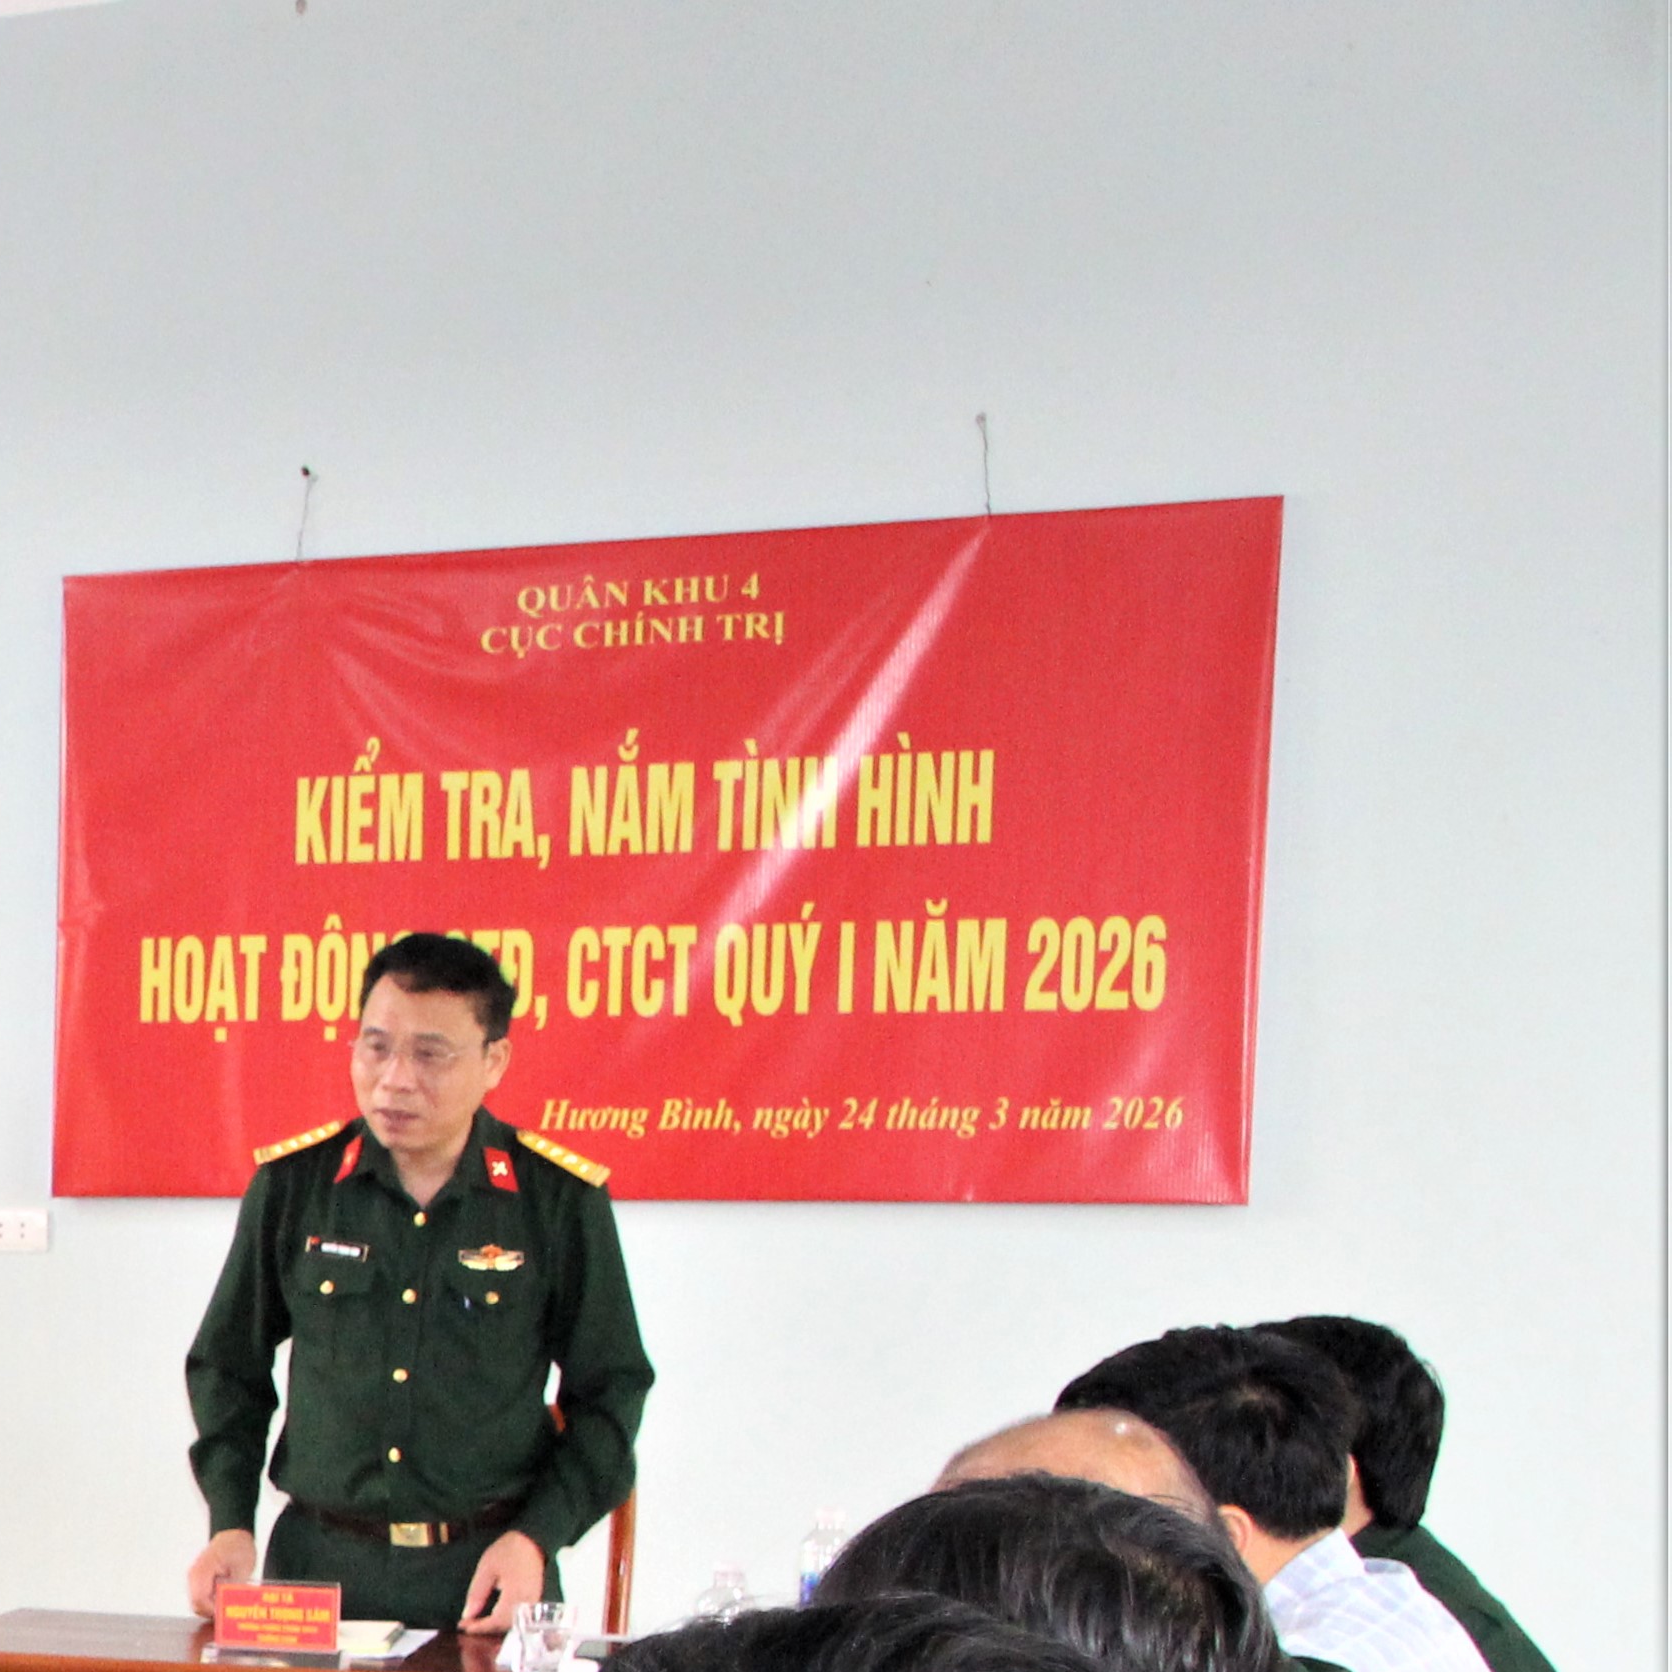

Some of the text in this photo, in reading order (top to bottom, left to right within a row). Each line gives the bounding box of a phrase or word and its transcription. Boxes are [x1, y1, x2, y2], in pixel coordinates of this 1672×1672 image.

[517, 572, 760, 618] QUÂN KHU 4
[480, 610, 785, 659] CỤC CHÍNH TRỊ
[295, 727, 996, 870] KIỂM TRA, NẮM TÌNH HÌNH
[139, 934, 268, 1043] HOẠT
[566, 924, 697, 1018] CTCT
[713, 902, 822, 1028] QUÝ
[837, 927, 855, 1015] I
[873, 898, 1008, 1014] NĂM
[1023, 913, 1168, 1012] 2026
[540, 1096, 1185, 1138] Hương Bình, ngày 24 tháng 3 năm 2026
